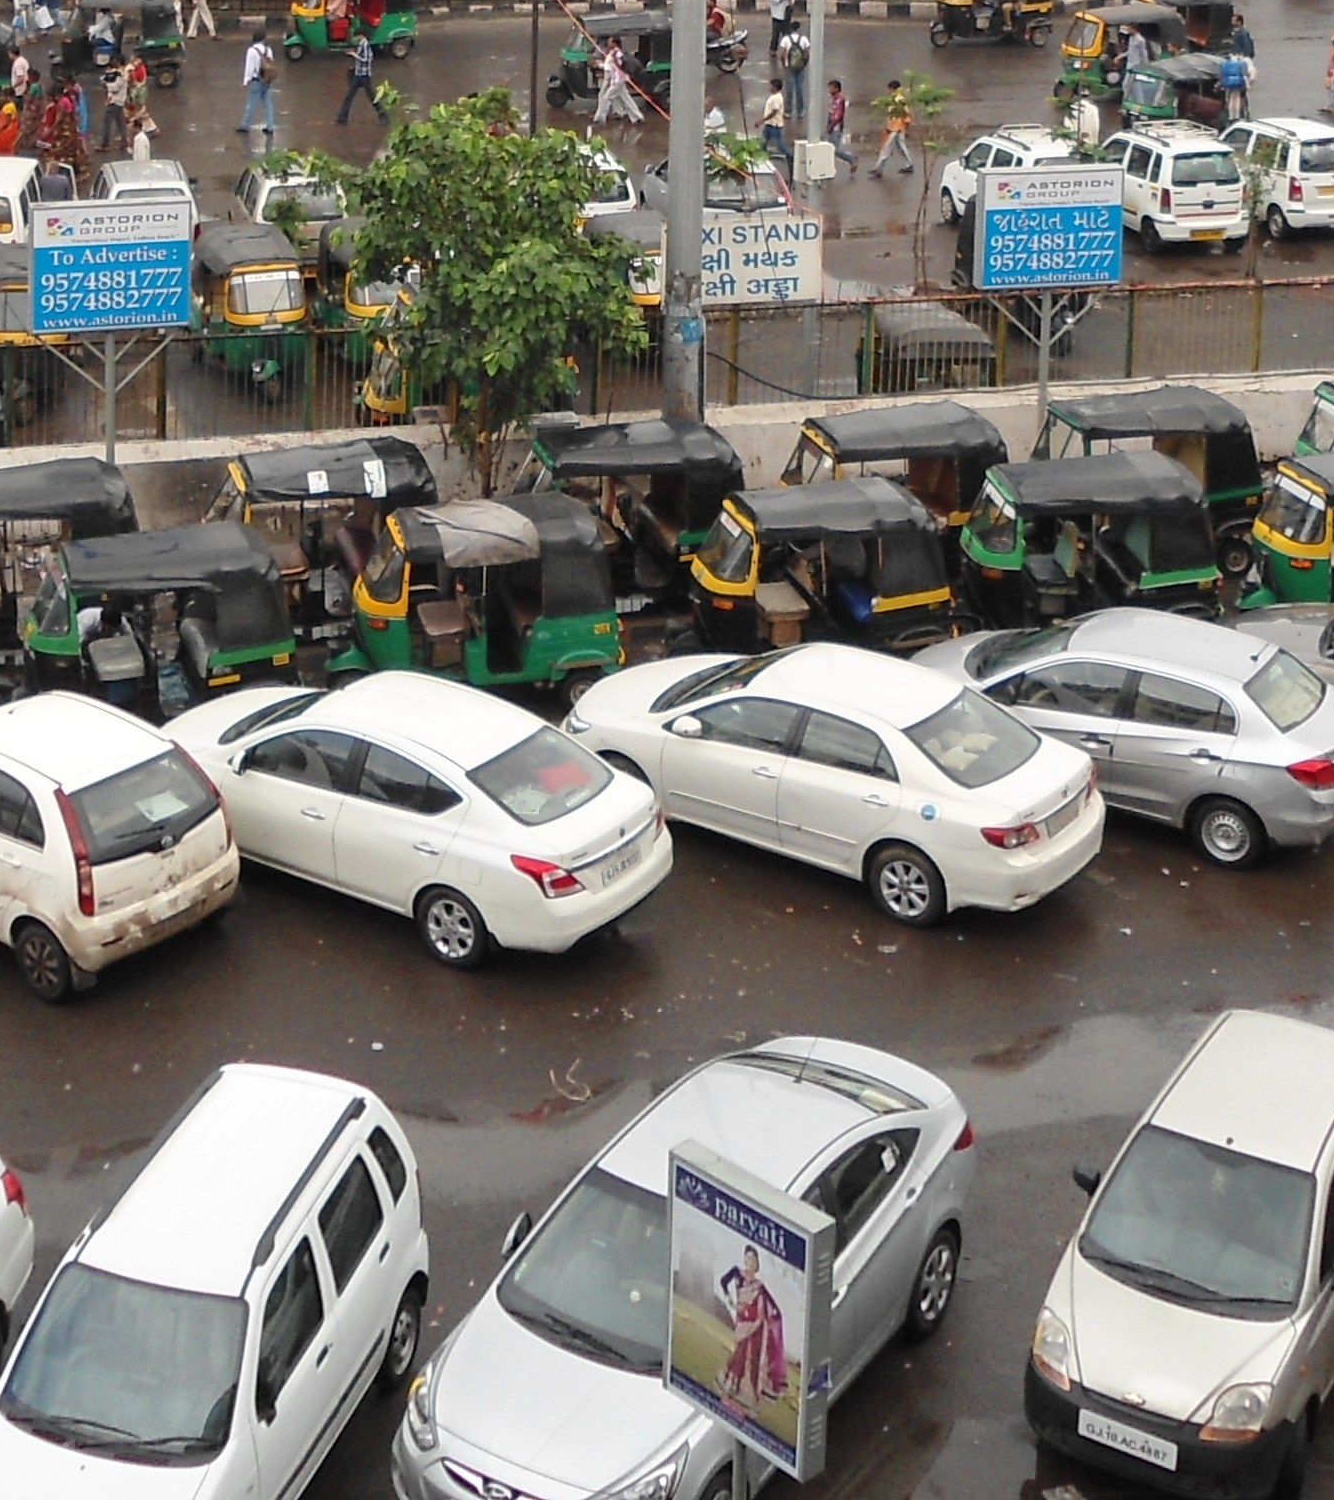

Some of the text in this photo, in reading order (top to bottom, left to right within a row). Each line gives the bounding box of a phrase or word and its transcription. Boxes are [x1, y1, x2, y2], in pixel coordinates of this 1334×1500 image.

[1026, 190, 1080, 199] GROUP
[1027, 180, 1115, 190] ASTORION
[80, 213, 180, 226] ASTORION
[993, 206, 1111, 233] જાહેરાત માટે
[79, 225, 142, 236] GROUP
[732, 222, 820, 244] STAND
[990, 231, 1117, 254] 9574881777
[49, 250, 74, 266] To
[80, 246, 167, 264] Advertise
[989, 250, 1115, 273] 9574882777
[40, 267, 183, 293] 9574881777
[991, 269, 1110, 285] www.astorion.in
[40, 287, 183, 314] 9574882777
[43, 310, 178, 329] www.astorion.in
[715, 1195, 786, 1251] parvati
